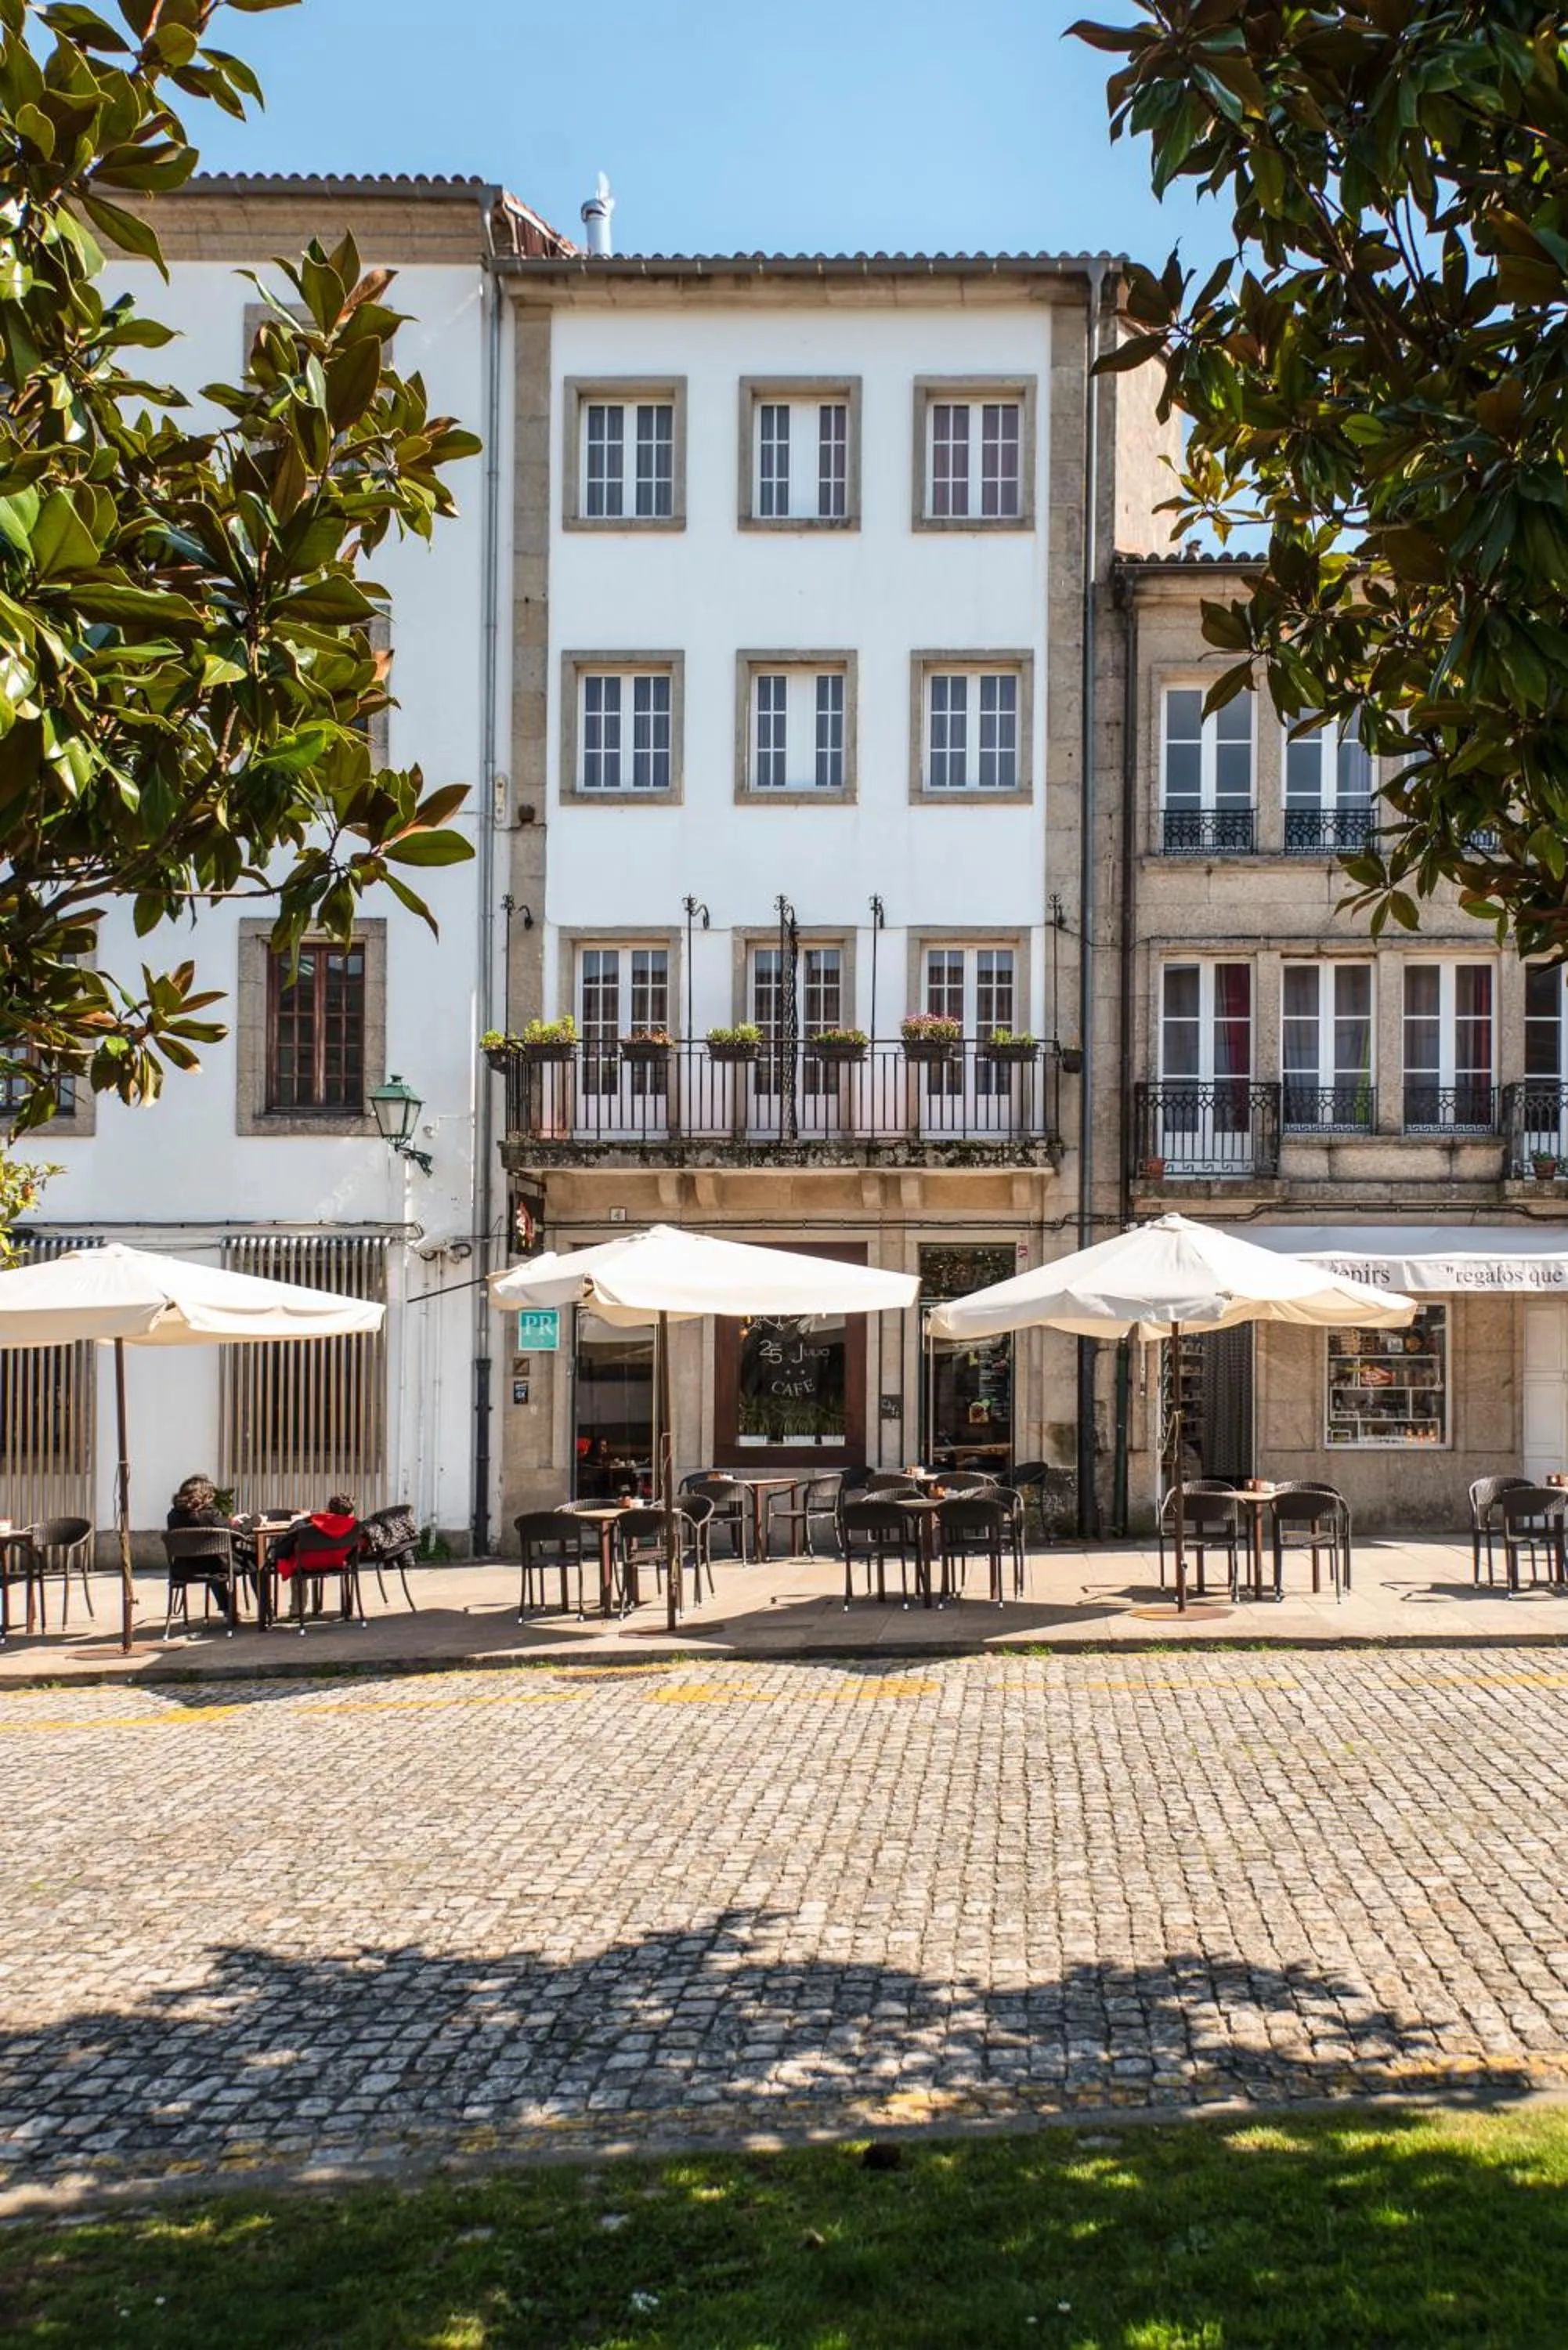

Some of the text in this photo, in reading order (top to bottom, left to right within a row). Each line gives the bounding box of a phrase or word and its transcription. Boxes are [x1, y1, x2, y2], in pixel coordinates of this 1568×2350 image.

[1528, 1268, 1563, 1287] que
[526, 1315, 553, 1335] PR
[758, 1340, 782, 1364] 25
